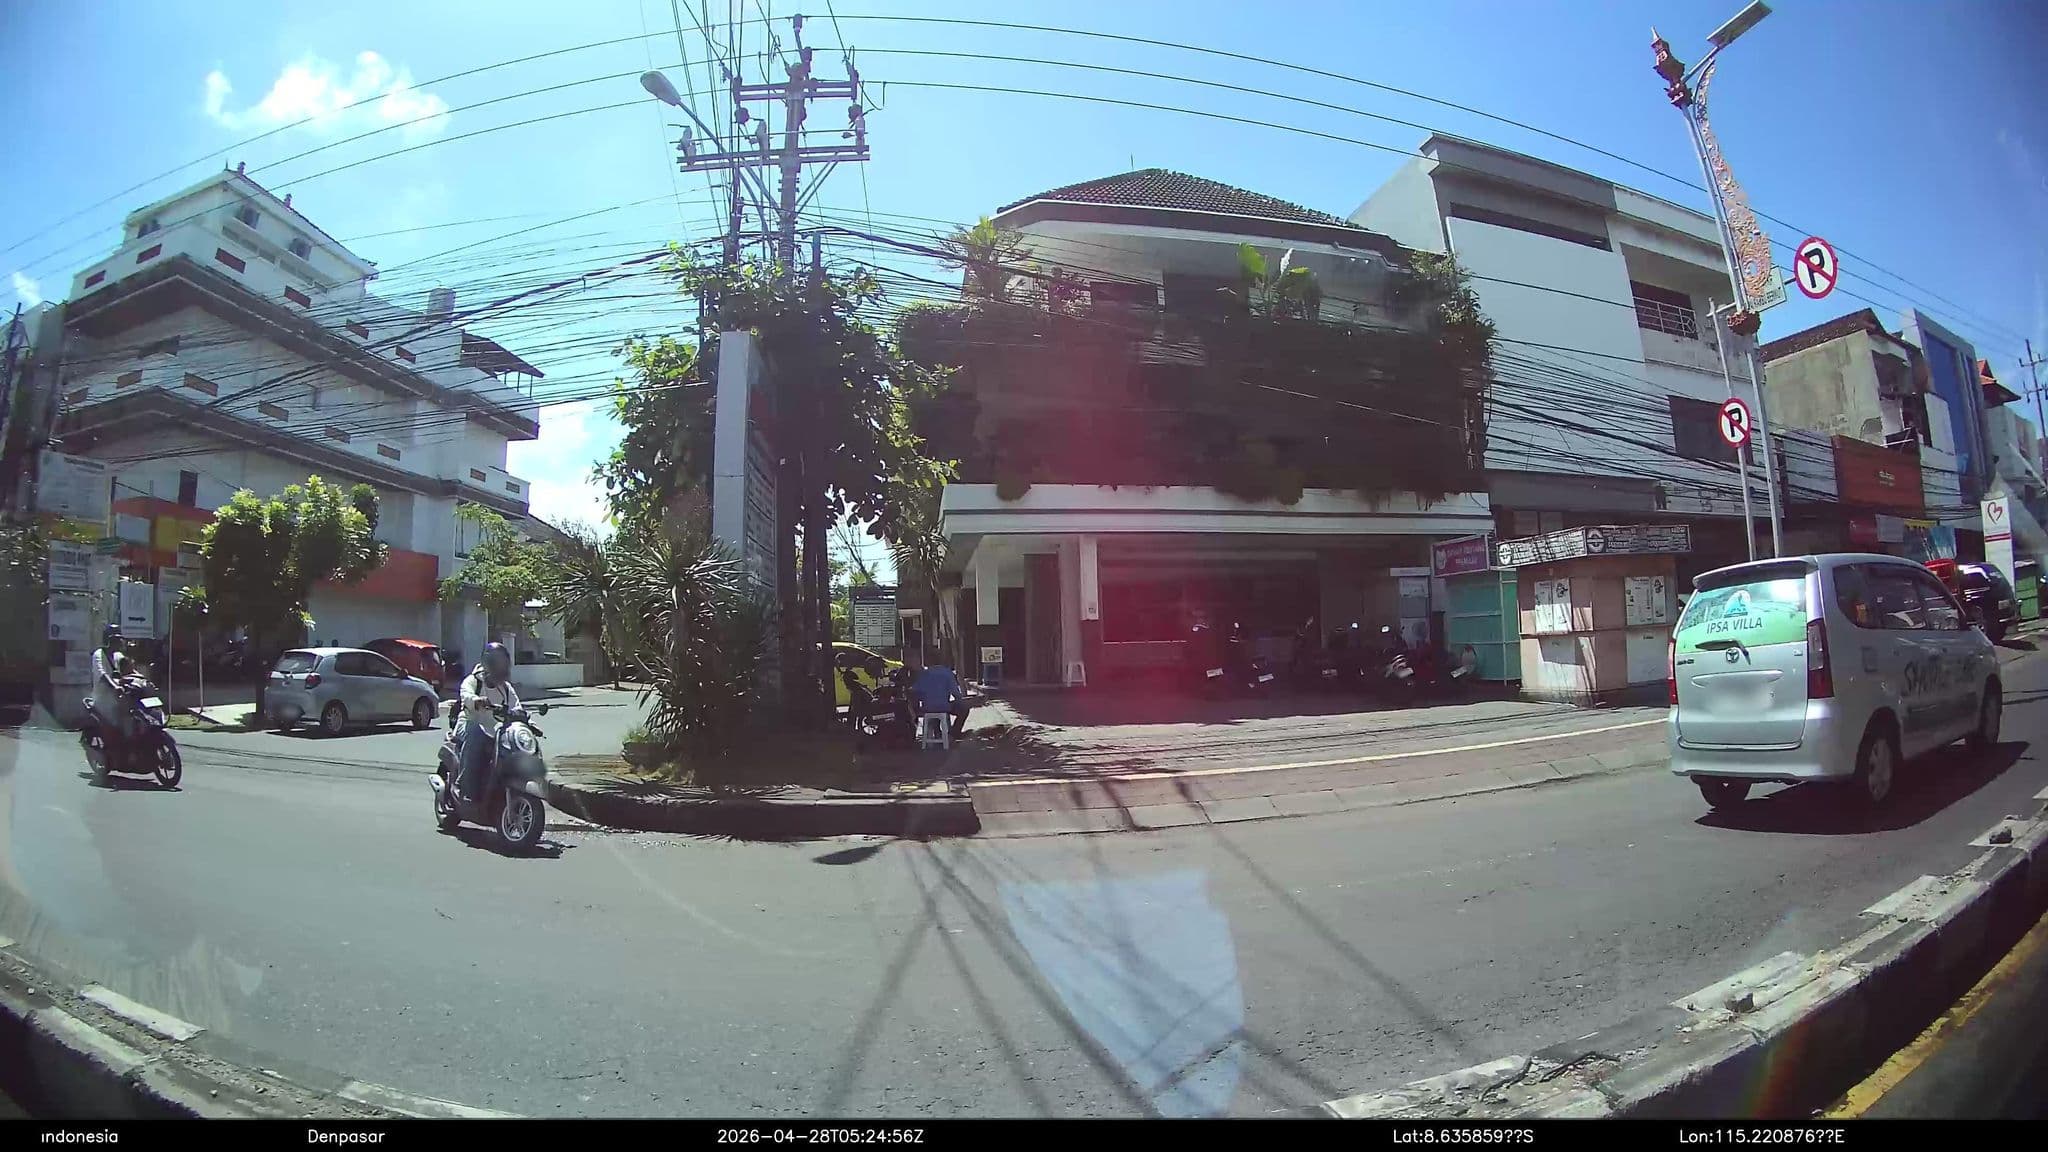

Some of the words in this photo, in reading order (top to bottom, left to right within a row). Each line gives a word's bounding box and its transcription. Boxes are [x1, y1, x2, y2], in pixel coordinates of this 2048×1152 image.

[1804, 247, 1825, 289] P
[1727, 407, 1743, 438] P
[1706, 620, 1730, 635] IPSA
[1732, 616, 1763, 631] VILLA
